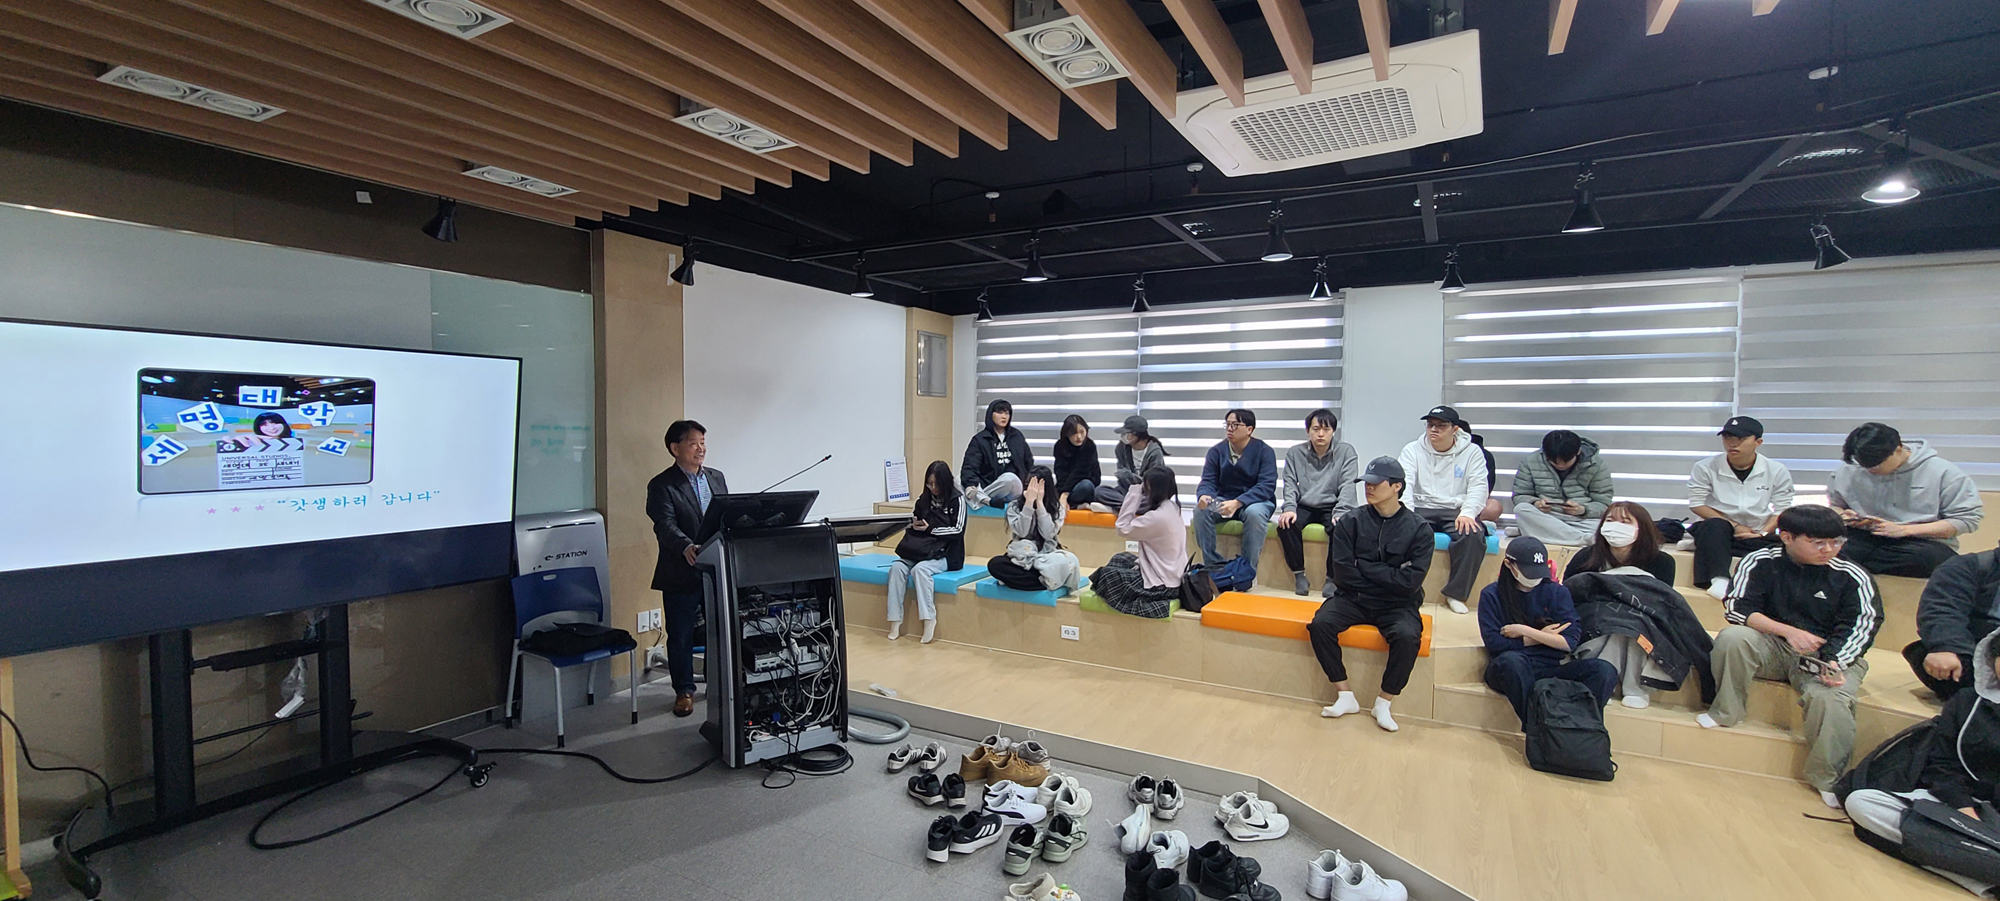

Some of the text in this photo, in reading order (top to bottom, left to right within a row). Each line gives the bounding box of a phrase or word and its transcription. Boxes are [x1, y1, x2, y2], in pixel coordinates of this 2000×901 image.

[147, 389, 348, 464] 세 명 대 학 교
[555, 550, 588, 560] STATION
[1533, 552, 1544, 564] NY
